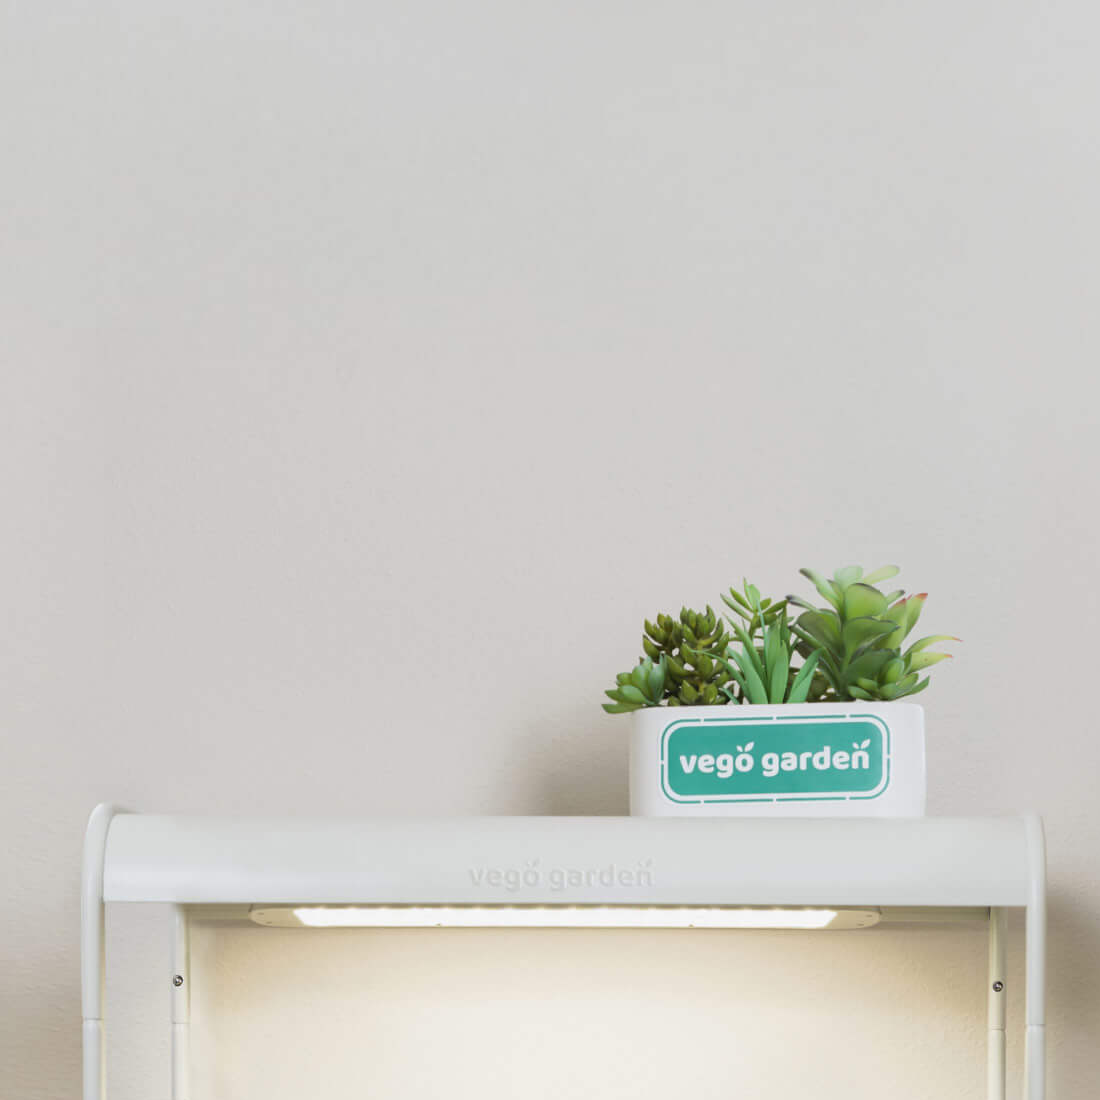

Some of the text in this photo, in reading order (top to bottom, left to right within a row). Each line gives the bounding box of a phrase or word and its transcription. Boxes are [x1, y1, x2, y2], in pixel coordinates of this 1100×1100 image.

[680, 739, 871, 779] vego garden
[468, 857, 654, 892] vego garden
